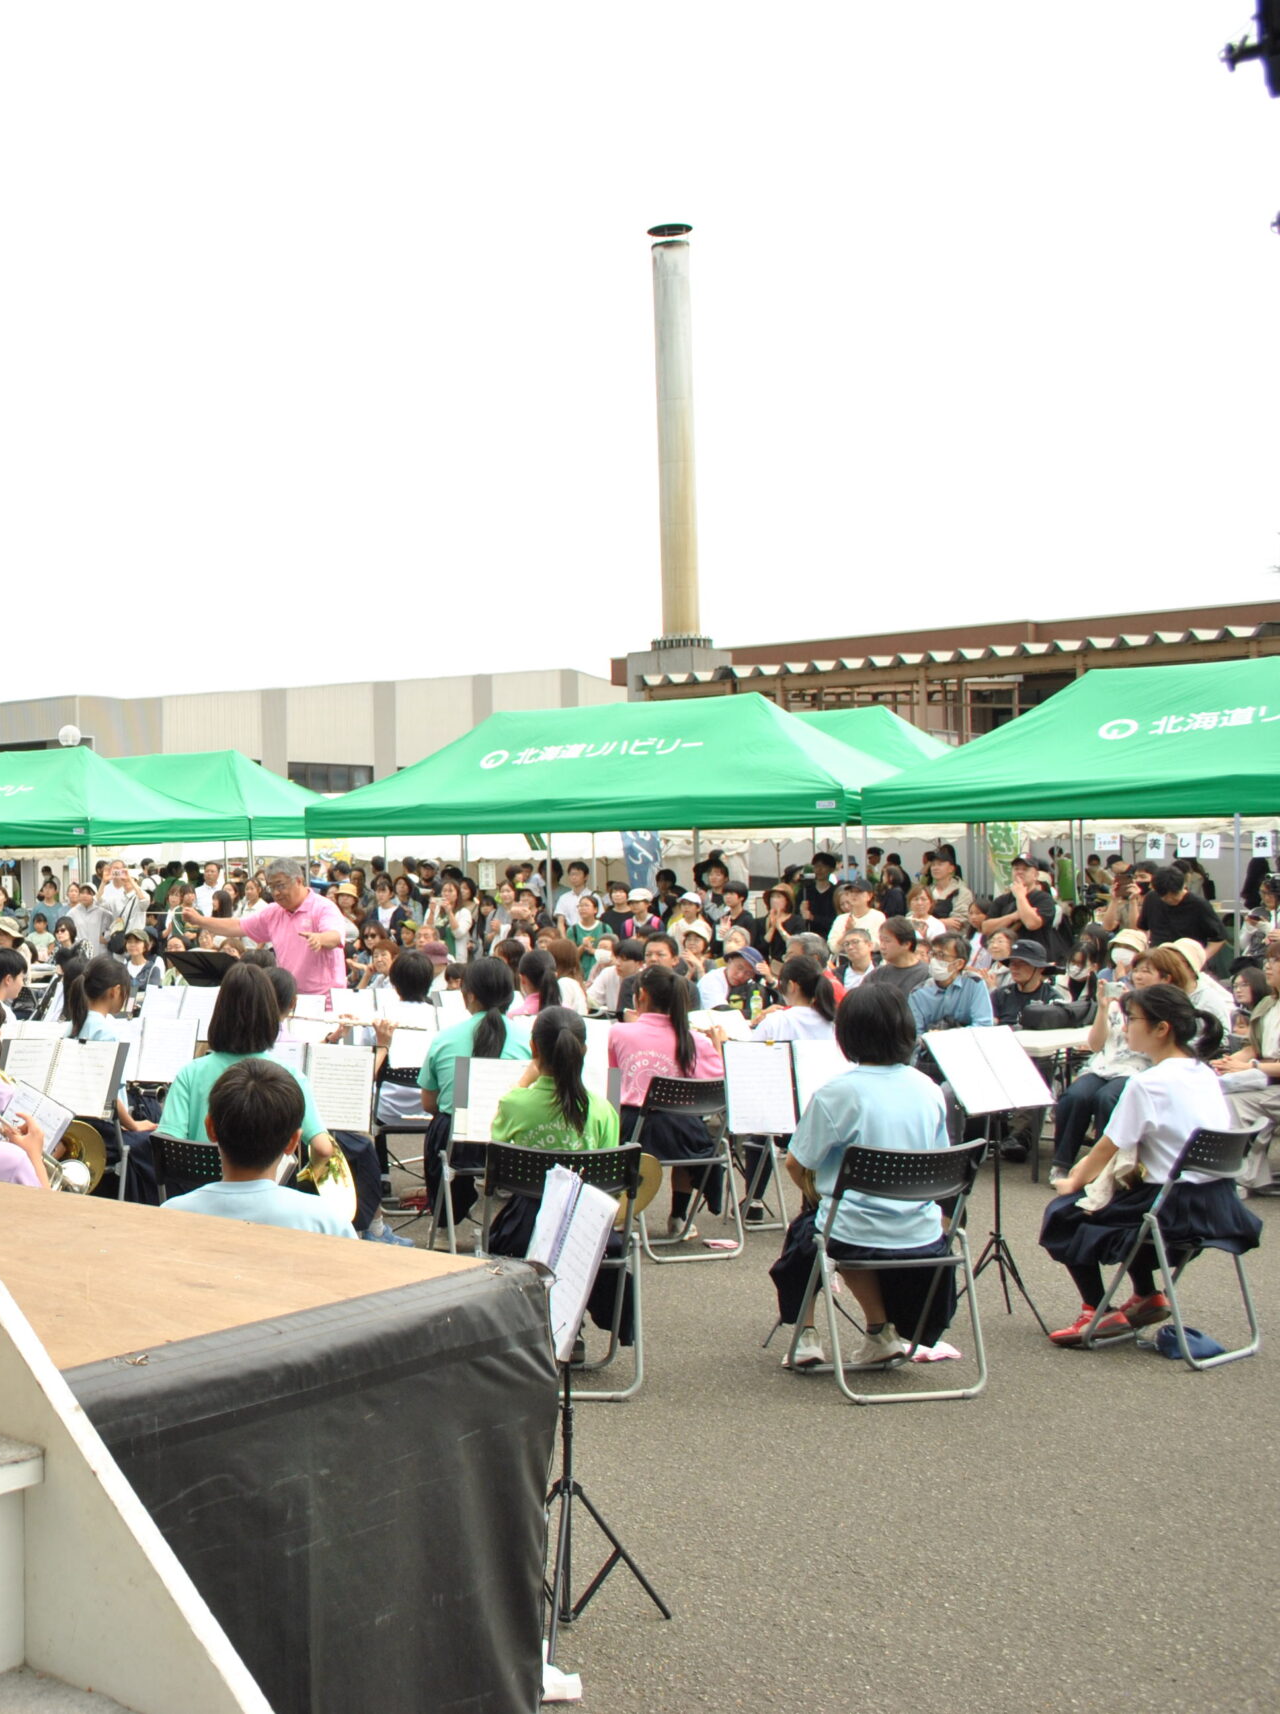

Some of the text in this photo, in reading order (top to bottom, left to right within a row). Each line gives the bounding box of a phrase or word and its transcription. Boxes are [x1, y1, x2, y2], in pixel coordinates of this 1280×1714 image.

[511, 738, 704, 766] 北海道リハビリー
